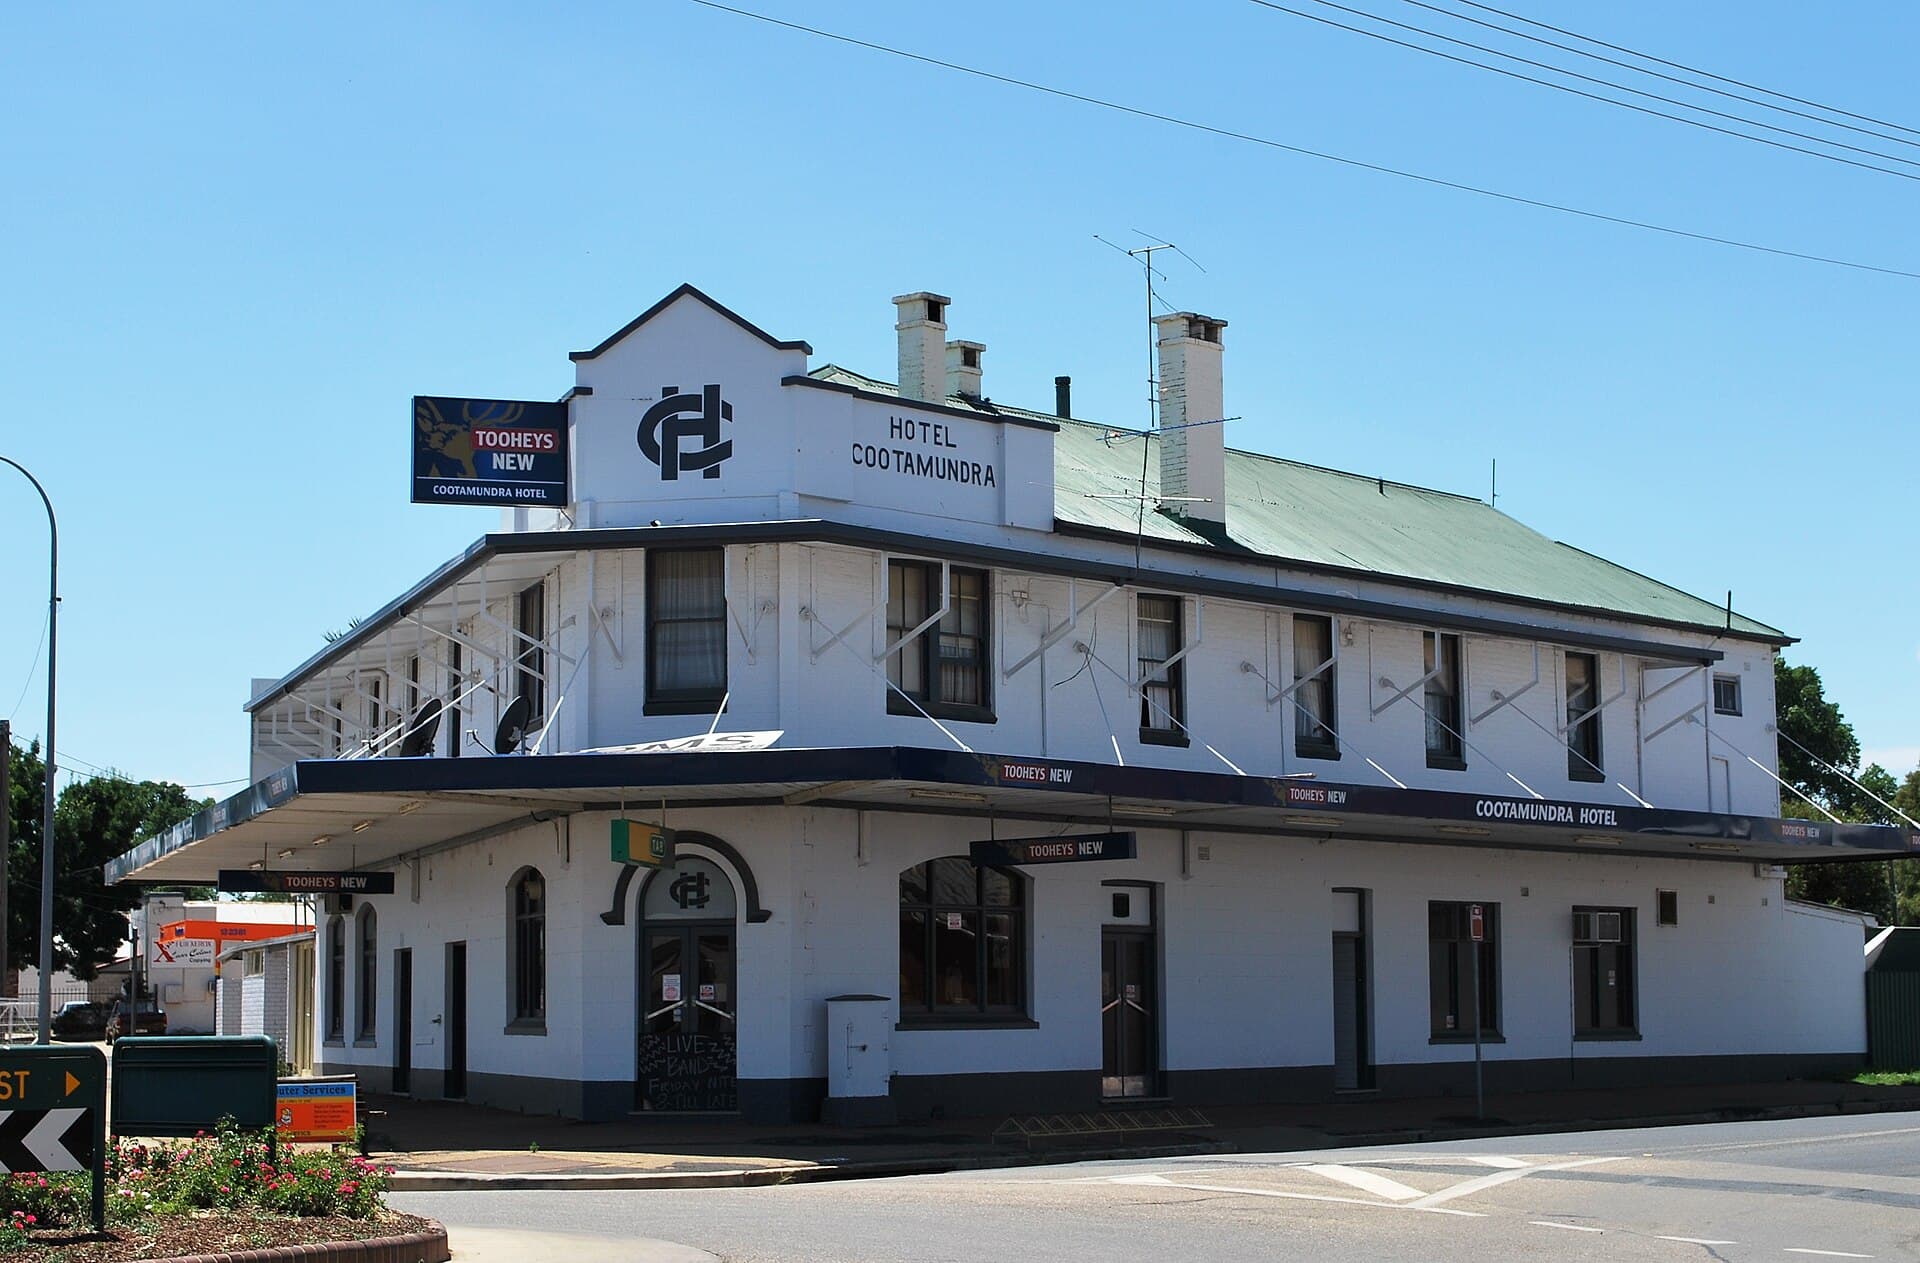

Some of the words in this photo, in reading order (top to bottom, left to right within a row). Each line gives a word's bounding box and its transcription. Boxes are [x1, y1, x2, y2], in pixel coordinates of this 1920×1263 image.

[475, 430, 554, 449] TOOHEYS
[890, 416, 957, 448] HOTEL
[492, 453, 535, 471] NEW
[852, 443, 996, 488] COOTAMUNDRA
[433, 484, 513, 498] COOTAMUNDRA
[515, 487, 547, 499] HOTEL
[1004, 764, 1046, 781] TOOHEYS
[1050, 768, 1073, 783] NEW
[1290, 787, 1325, 802] TOOHEYS
[1328, 790, 1346, 804] NEW
[1476, 800, 1574, 823] COOTAMUNDRA
[1579, 809, 1617, 826] HOTEL
[1807, 826, 1821, 838] NEW
[1029, 843, 1073, 857] TOOHEYS
[1078, 841, 1103, 855] NEW
[286, 876, 335, 888] TOOHEYS
[340, 877, 367, 888] NEW
[667, 1035, 708, 1055] LIVE
[277, 1086, 299, 1096] uter
[303, 1085, 346, 1095] Services
